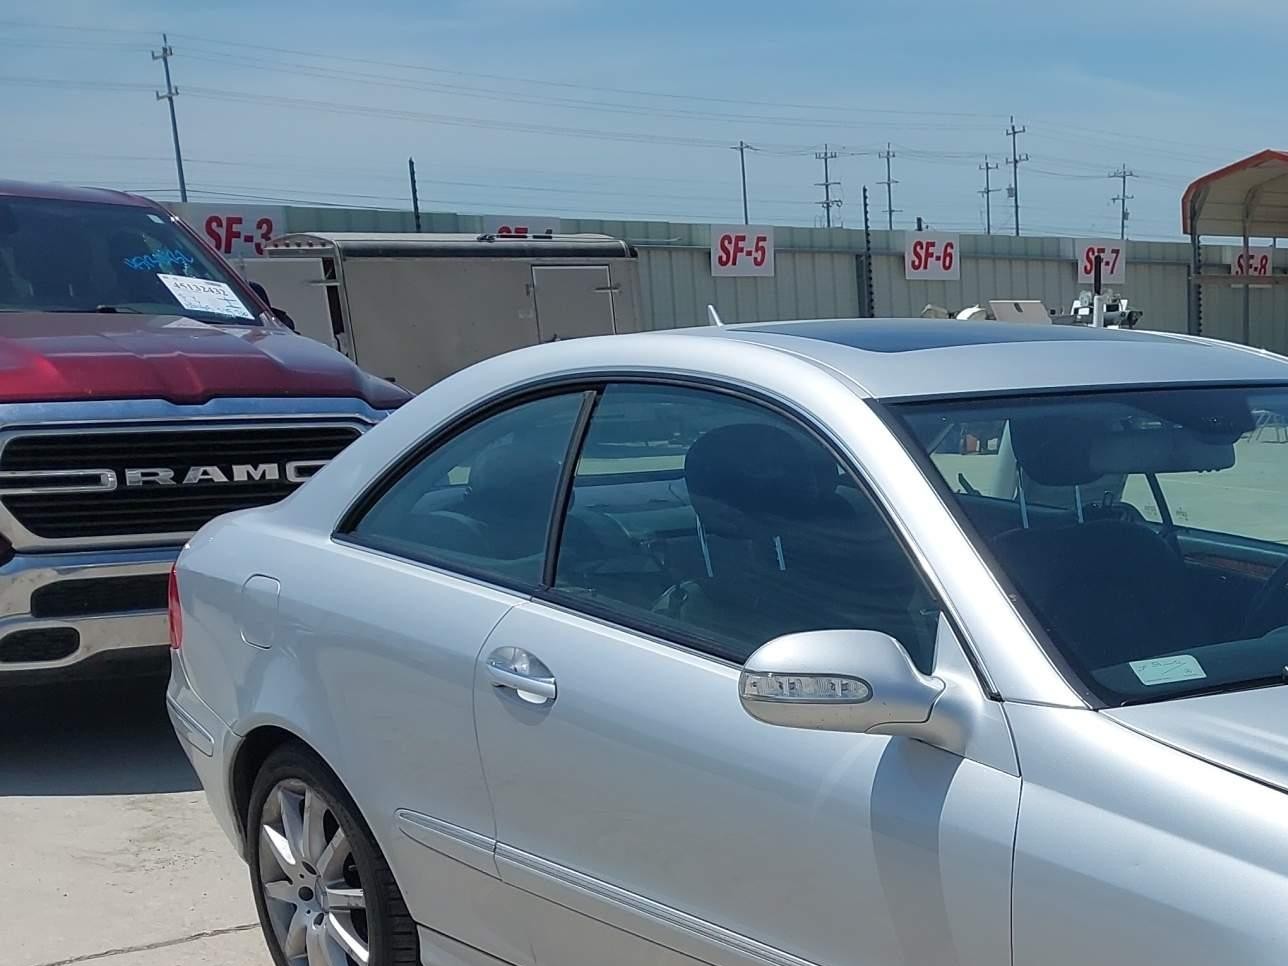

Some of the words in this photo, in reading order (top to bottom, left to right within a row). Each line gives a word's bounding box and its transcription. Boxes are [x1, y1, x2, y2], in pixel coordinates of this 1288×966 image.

[205, 215, 273, 254] SF-3
[717, 234, 767, 267] SF-5
[911, 240, 953, 271] SF-6
[125, 463, 281, 486] RAM
